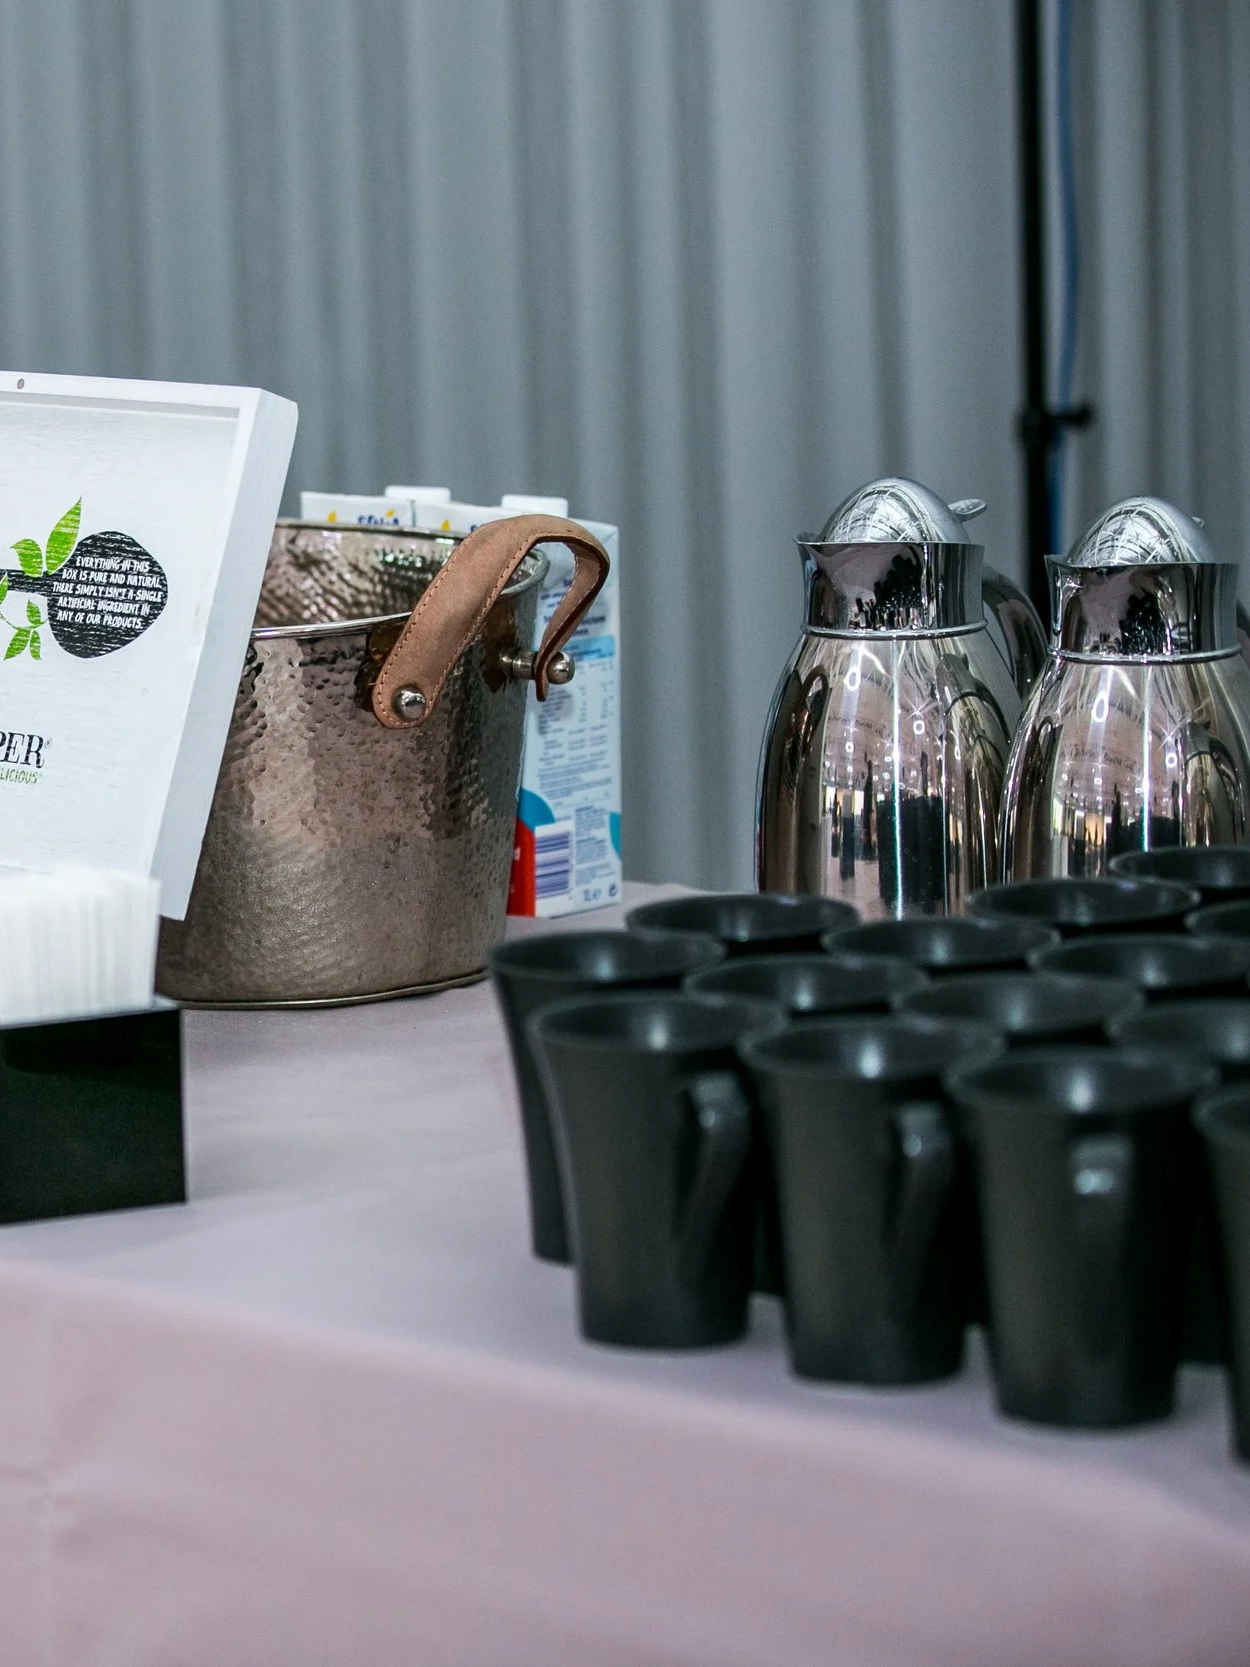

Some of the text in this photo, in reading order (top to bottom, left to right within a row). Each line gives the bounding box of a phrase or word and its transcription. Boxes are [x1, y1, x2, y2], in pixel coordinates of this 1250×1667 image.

[76, 556, 150, 573] EVERYTHING IN THIS
[62, 569, 77, 580] BOX
[79, 570, 87, 580] IS
[89, 571, 108, 583] PURE
[109, 573, 126, 584] AND
[52, 582, 74, 593] THERE
[75, 584, 103, 597] SIMPLY
[127, 589, 134, 600] A
[135, 589, 164, 602] SINGLE
[57, 597, 150, 617] ARTIFICIAL INGREDIENT IN
[57, 611, 73, 622] ANY
[75, 612, 85, 623] OF
[86, 613, 101, 624] OUR
